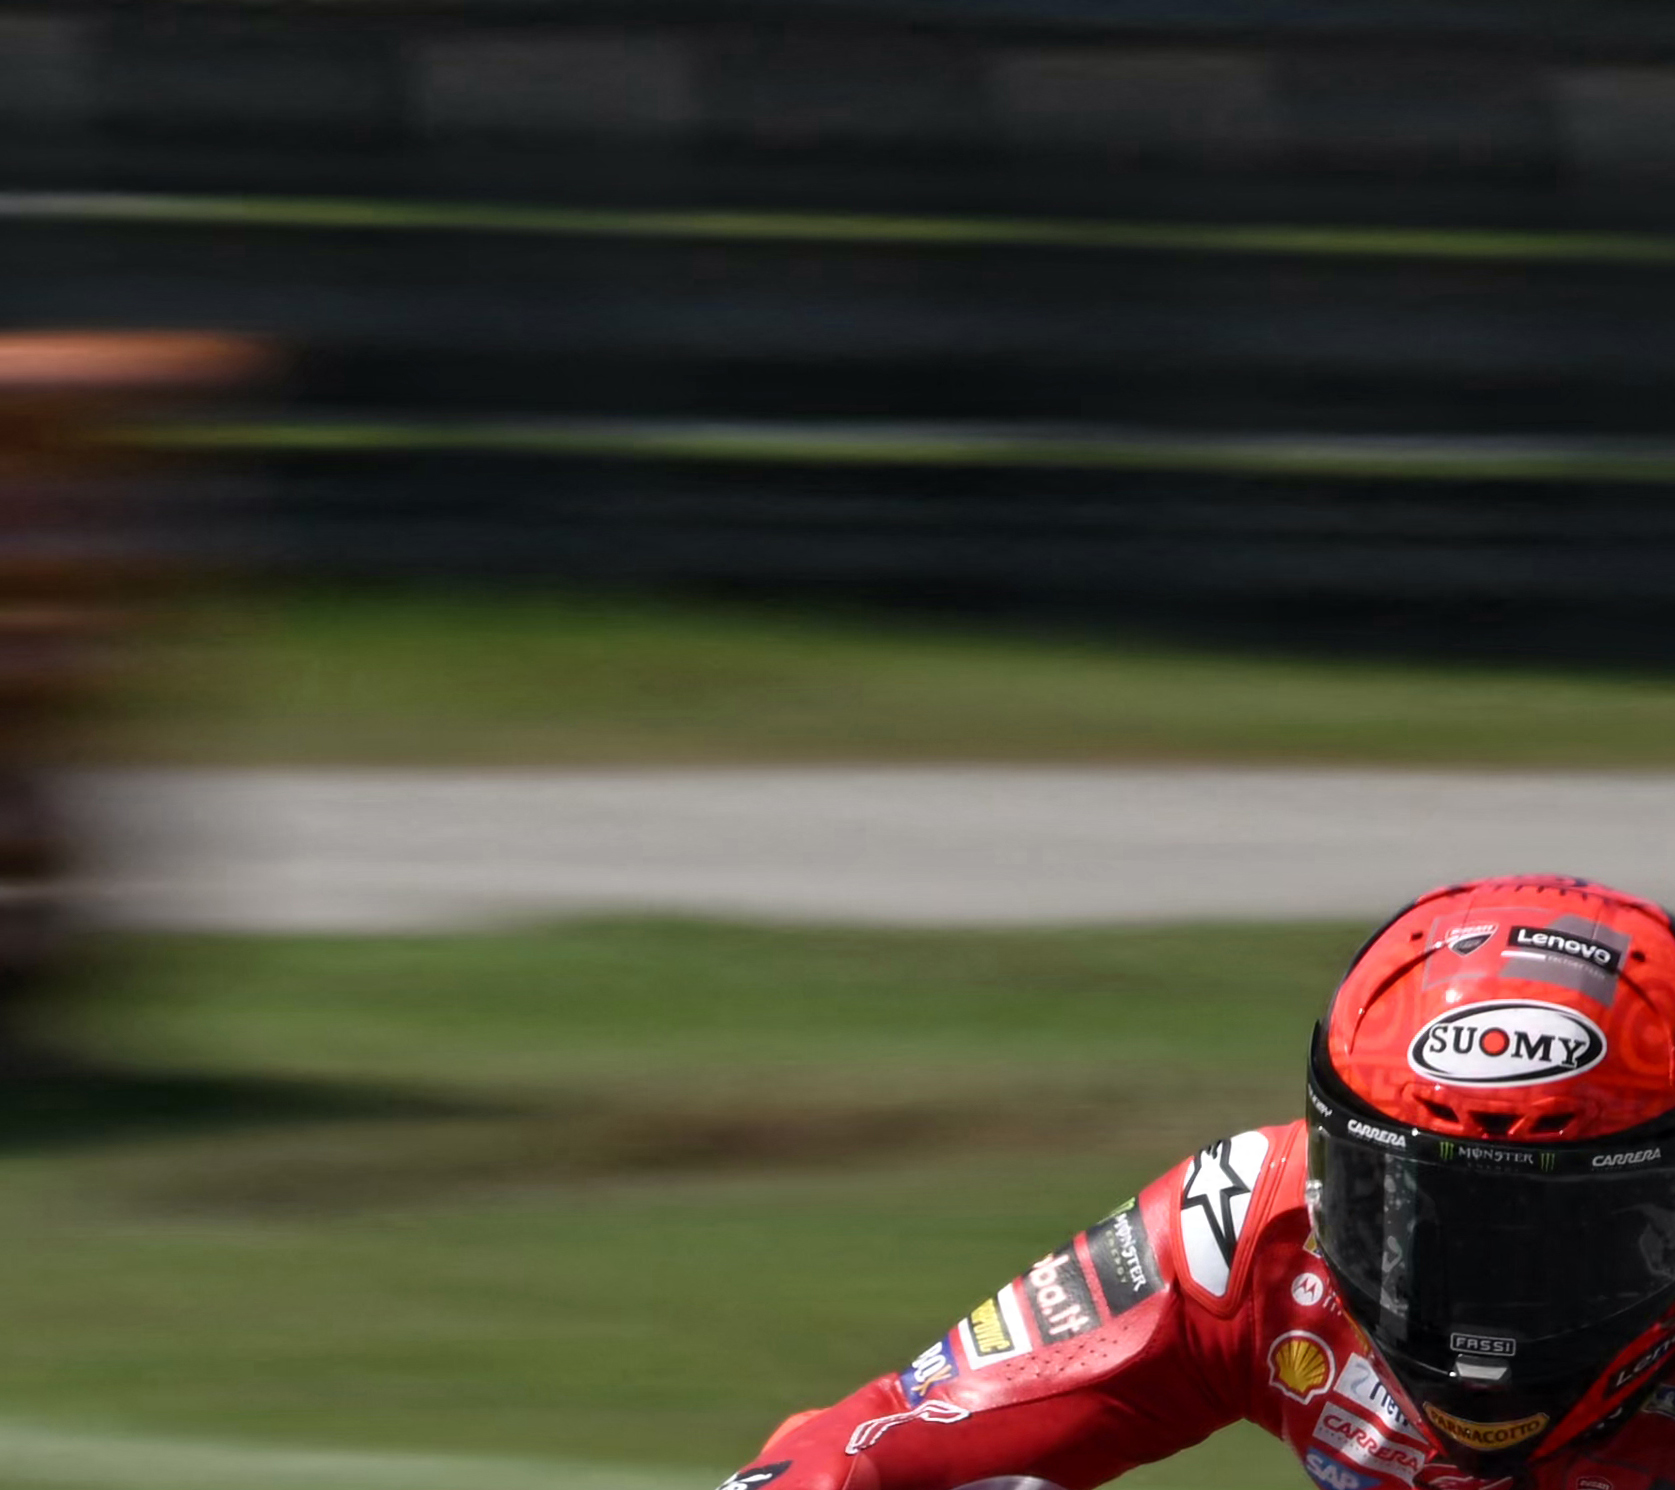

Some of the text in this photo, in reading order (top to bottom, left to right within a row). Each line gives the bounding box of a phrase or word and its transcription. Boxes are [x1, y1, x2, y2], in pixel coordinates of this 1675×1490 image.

[1516, 928, 1611, 965] Lenovo
[1429, 1025, 1586, 1068] SUOMY
[1347, 1118, 1407, 1148] CARRERA
[1458, 1145, 1534, 1165] MONSTER
[1591, 1147, 1662, 1168] CARRERA
[1114, 1212, 1146, 1291] MONSTER
[1455, 1336, 1511, 1353] FASSI
[1323, 1413, 1419, 1472] CARRERA
[1431, 1410, 1541, 1444] PARMACOTTO
